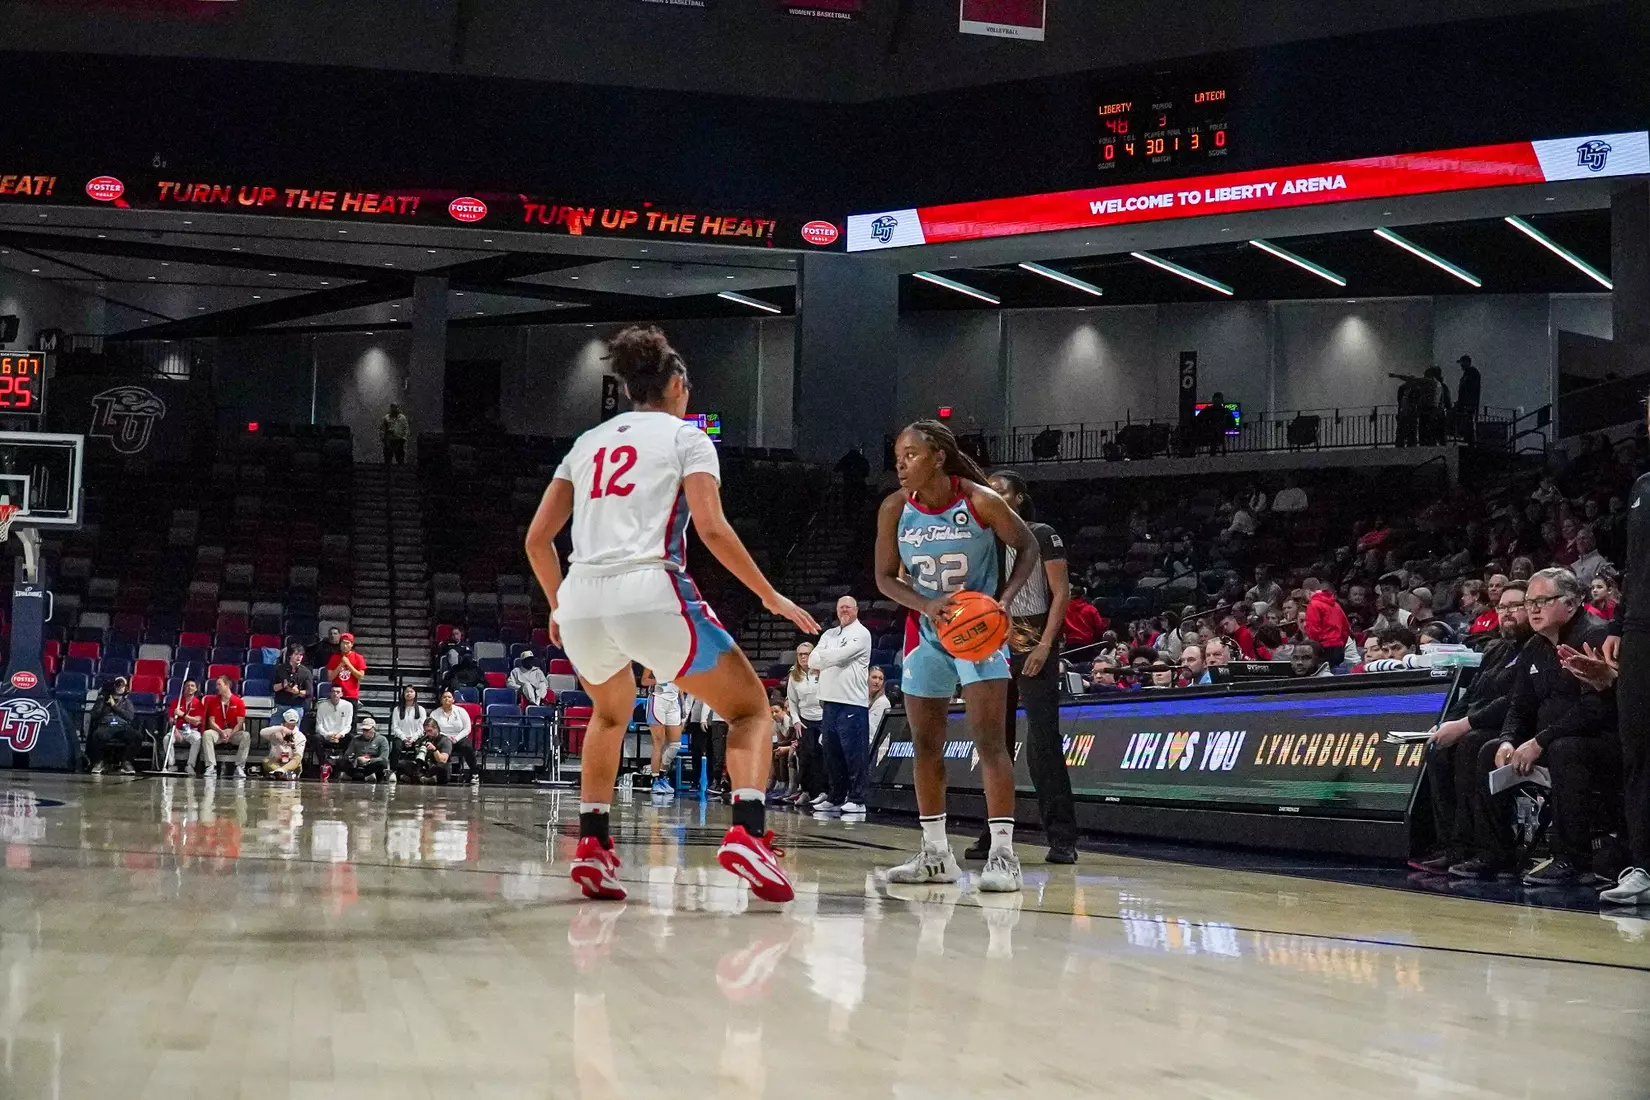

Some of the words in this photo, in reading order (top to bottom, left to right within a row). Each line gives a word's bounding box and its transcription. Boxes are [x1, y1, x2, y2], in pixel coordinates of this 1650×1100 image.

[789, 8, 815, 17] WOMEN'S
[816, 11, 851, 20] BASKETBALL
[986, 27, 1019, 36] VOLLEYBALL
[1099, 102, 1132, 115] LIBERTY
[1146, 138, 1165, 155] 30
[1174, 137, 1179, 151] 1
[1190, 134, 1199, 150] 3
[1215, 130, 1226, 147] 0
[1104, 144, 1115, 160] 0
[1125, 143, 1134, 156] 4
[0, 174, 57, 196] EAT!
[89, 183, 121, 192] FOSTER
[157, 181, 232, 204] TURN
[237, 185, 277, 206] UP
[284, 188, 337, 211] THE
[340, 191, 421, 216] HEAT!
[1089, 193, 1174, 215] WELCOME
[1177, 190, 1202, 206] TO
[1205, 182, 1278, 204] LIBERTY
[1282, 174, 1347, 196] ARENA
[451, 204, 484, 214] FOSTER
[523, 203, 596, 228] TURN
[600, 208, 639, 230] UP
[645, 211, 697, 234] THE
[700, 215, 777, 239] HEAT!
[803, 227, 836, 236] FOSTER
[1182, 361, 1195, 389] 20
[0, 376, 32, 407] 25
[590, 445, 638, 499] 12
[911, 553, 968, 592] 22
[951, 621, 989, 645] ELITE
[944, 741, 973, 758] AIRPORT
[1065, 734, 1096, 766] LYH
[1120, 732, 1162, 769] LYH
[1199, 730, 1247, 771] YOU
[1254, 732, 1382, 772] LYNCHBURG,
